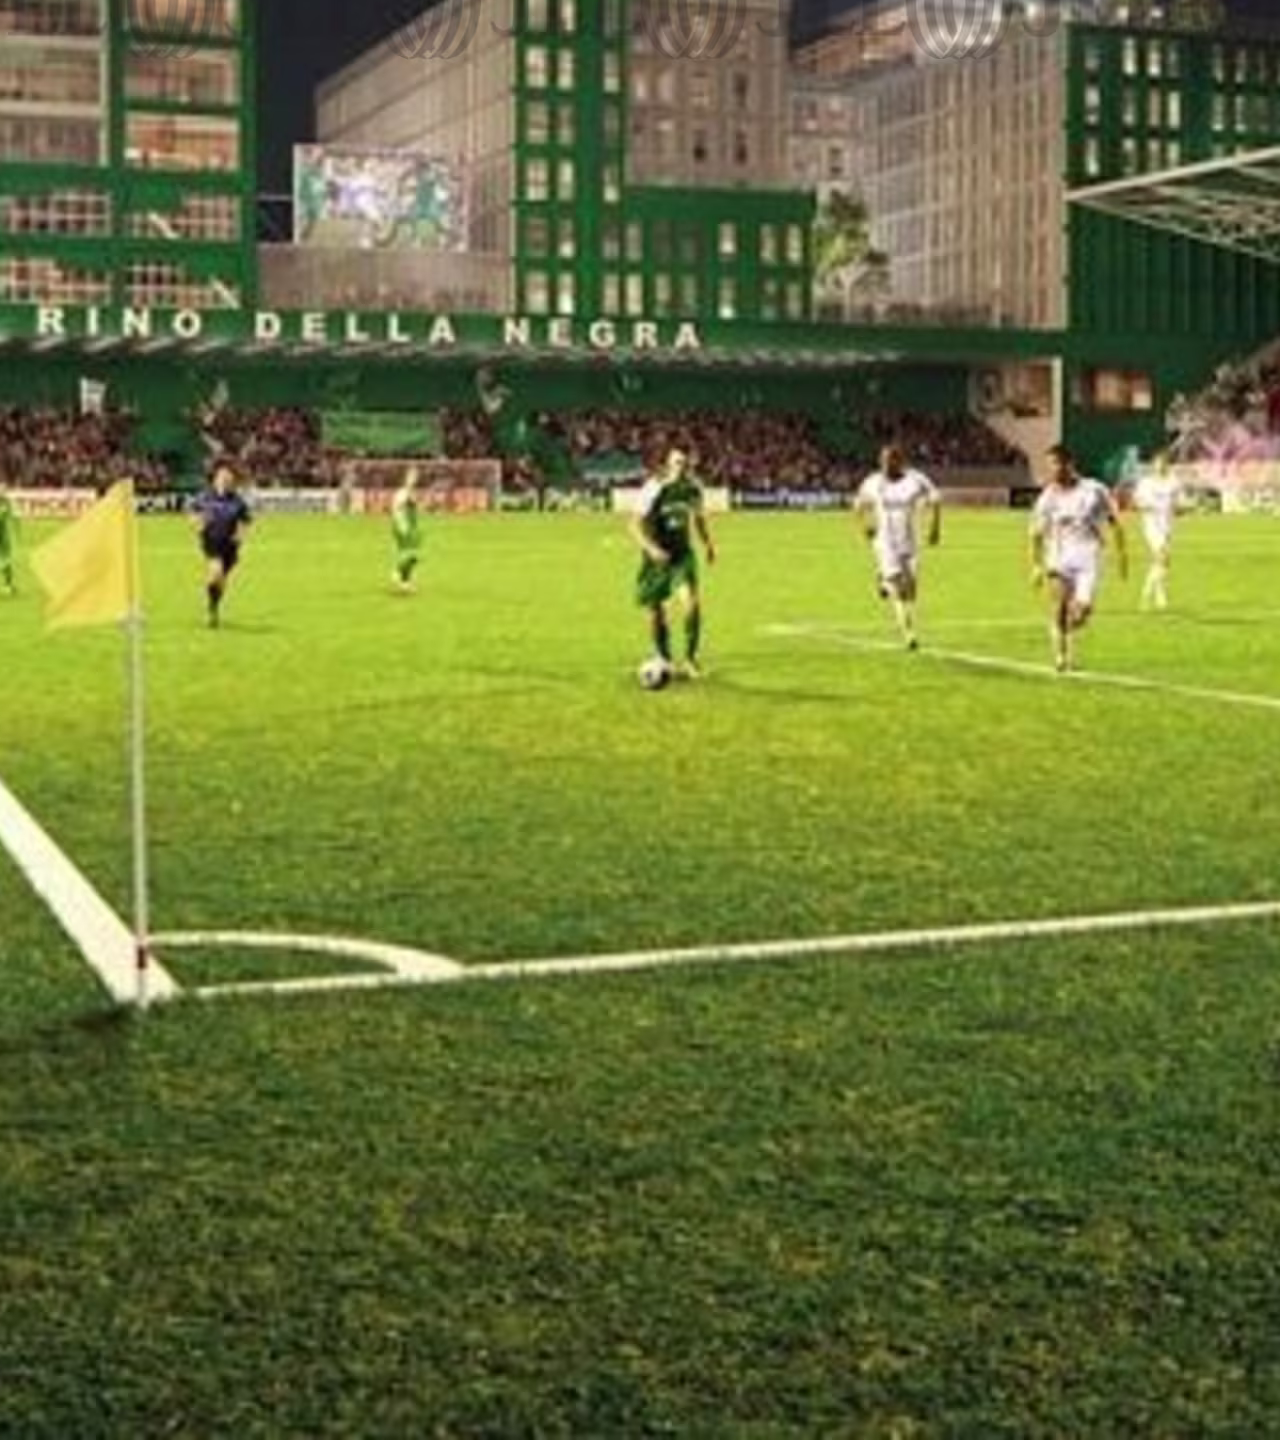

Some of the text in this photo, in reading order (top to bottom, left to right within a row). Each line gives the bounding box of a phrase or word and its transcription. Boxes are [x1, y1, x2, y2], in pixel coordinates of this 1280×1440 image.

[36, 307, 702, 350] RINO DELLA NEGRA
